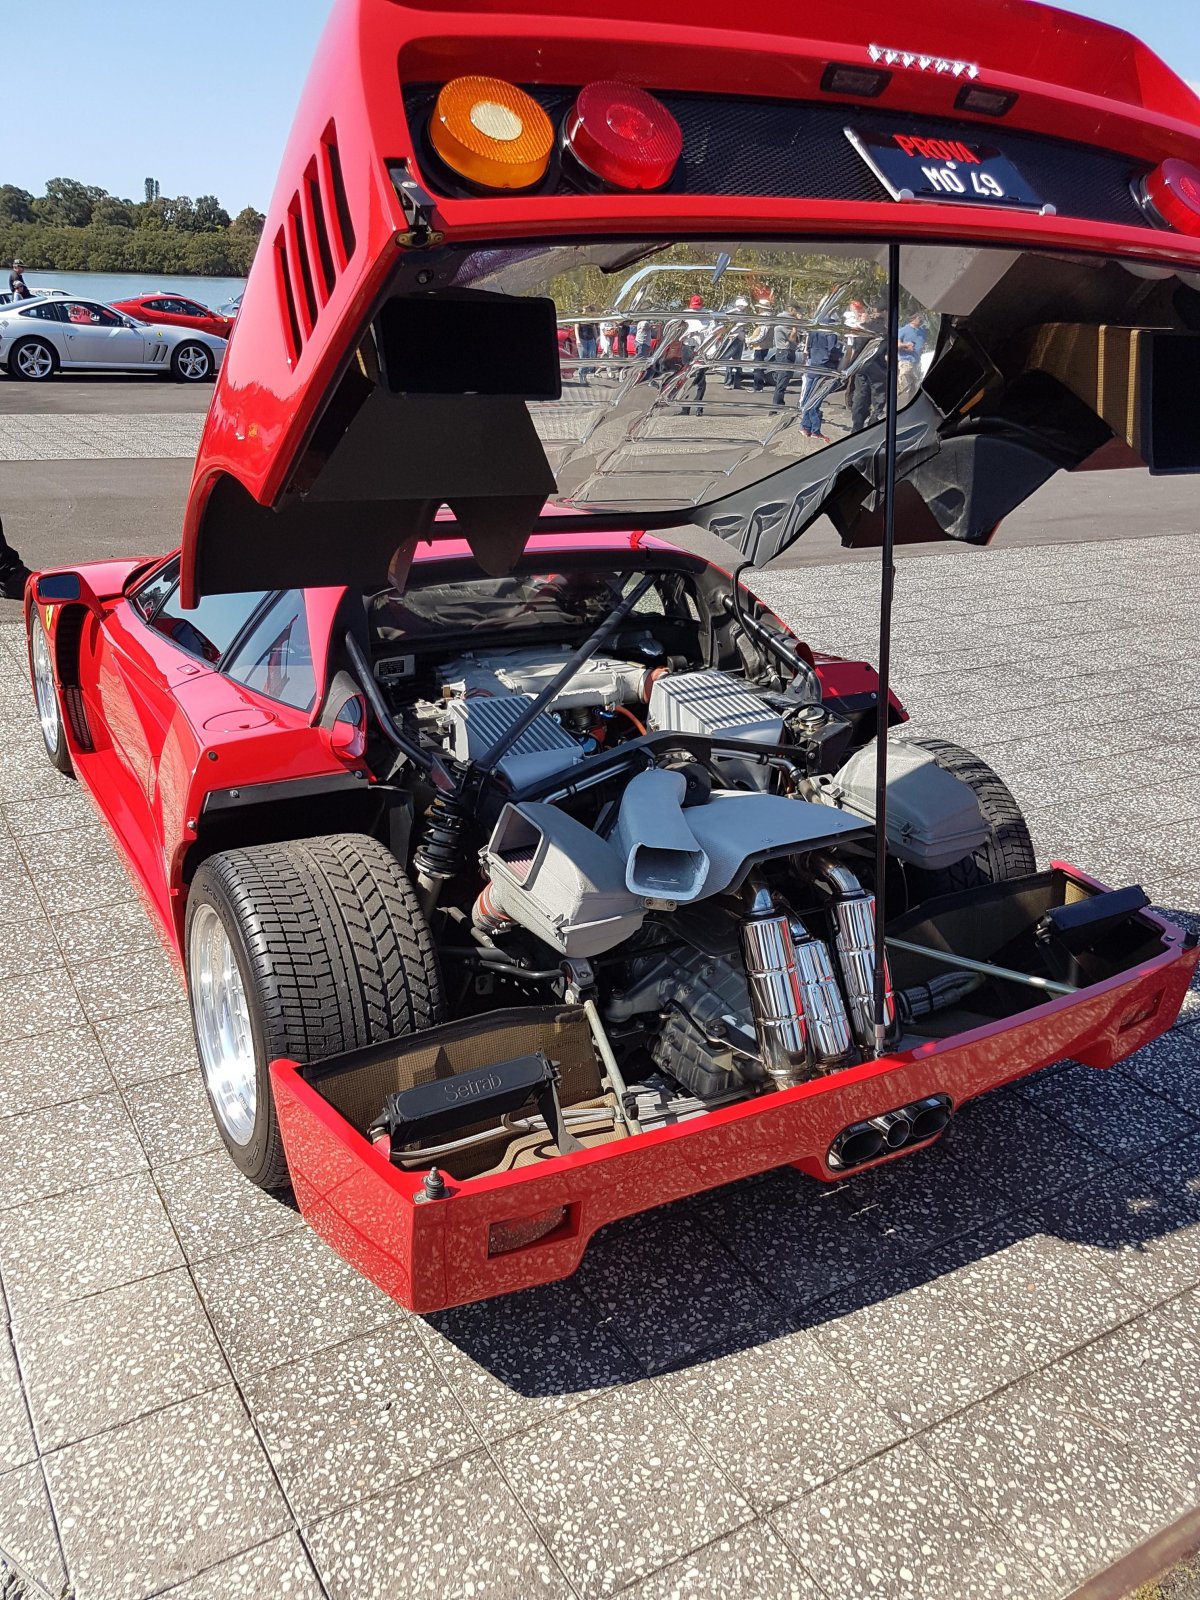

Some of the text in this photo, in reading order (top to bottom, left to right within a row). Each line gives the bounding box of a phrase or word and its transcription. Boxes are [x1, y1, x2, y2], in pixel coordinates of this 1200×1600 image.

[892, 134, 981, 164] PROVA
[971, 171, 1004, 197] 49
[444, 1073, 502, 1102] Setrab
